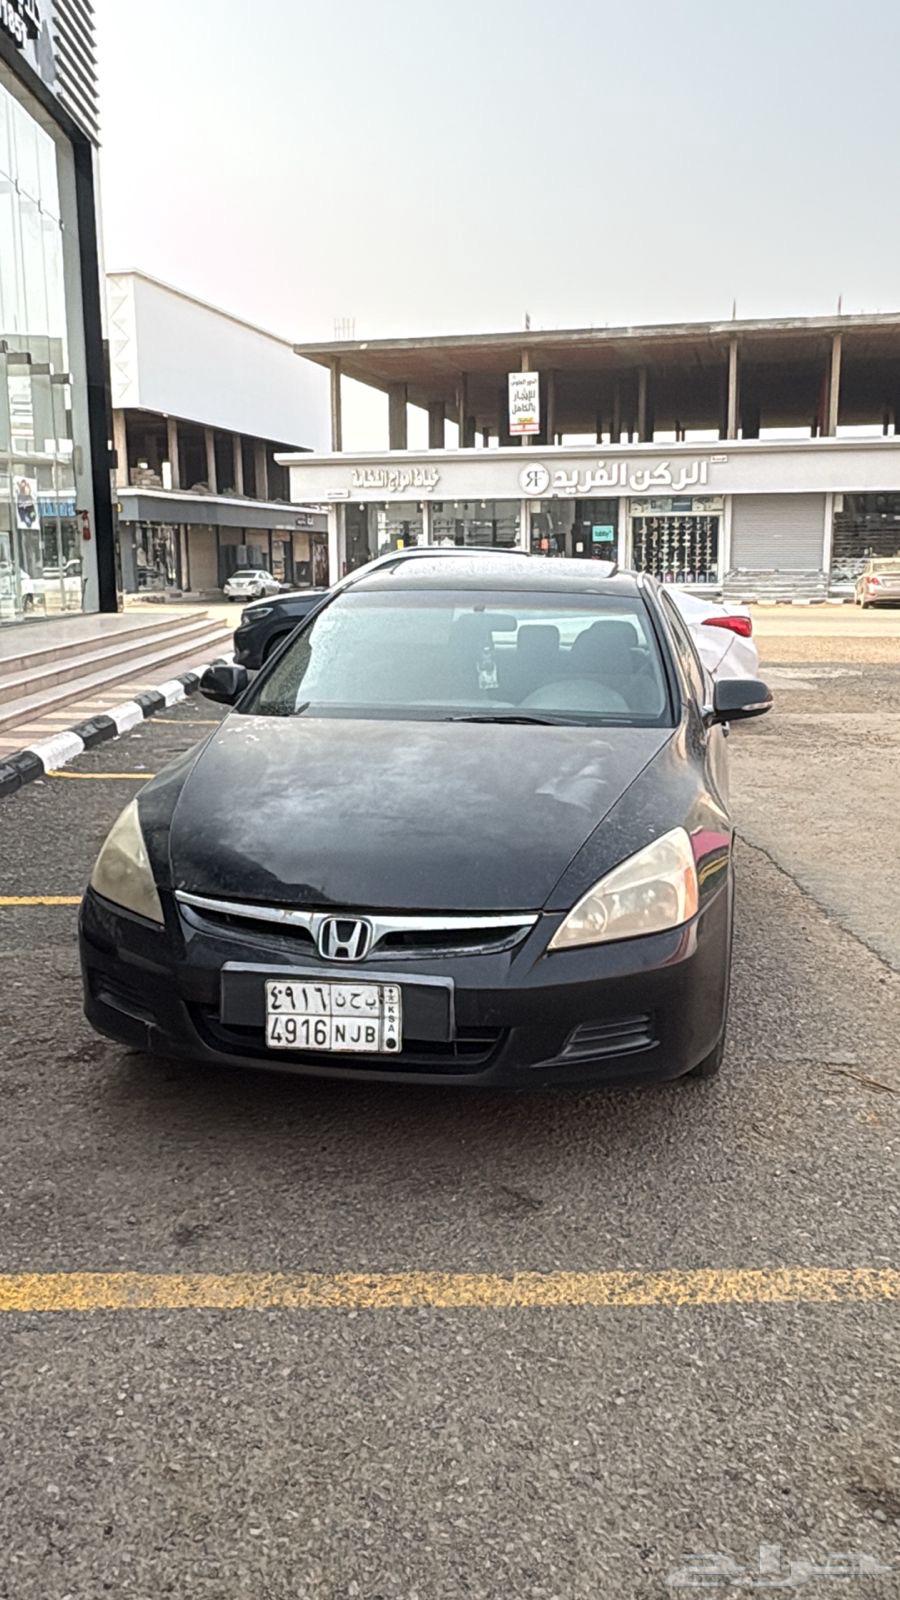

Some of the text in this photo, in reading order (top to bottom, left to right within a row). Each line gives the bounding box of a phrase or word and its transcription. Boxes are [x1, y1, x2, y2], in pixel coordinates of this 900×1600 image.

[553, 460, 708, 494] الركن الفريد
[270, 1017, 327, 1046] 4916
